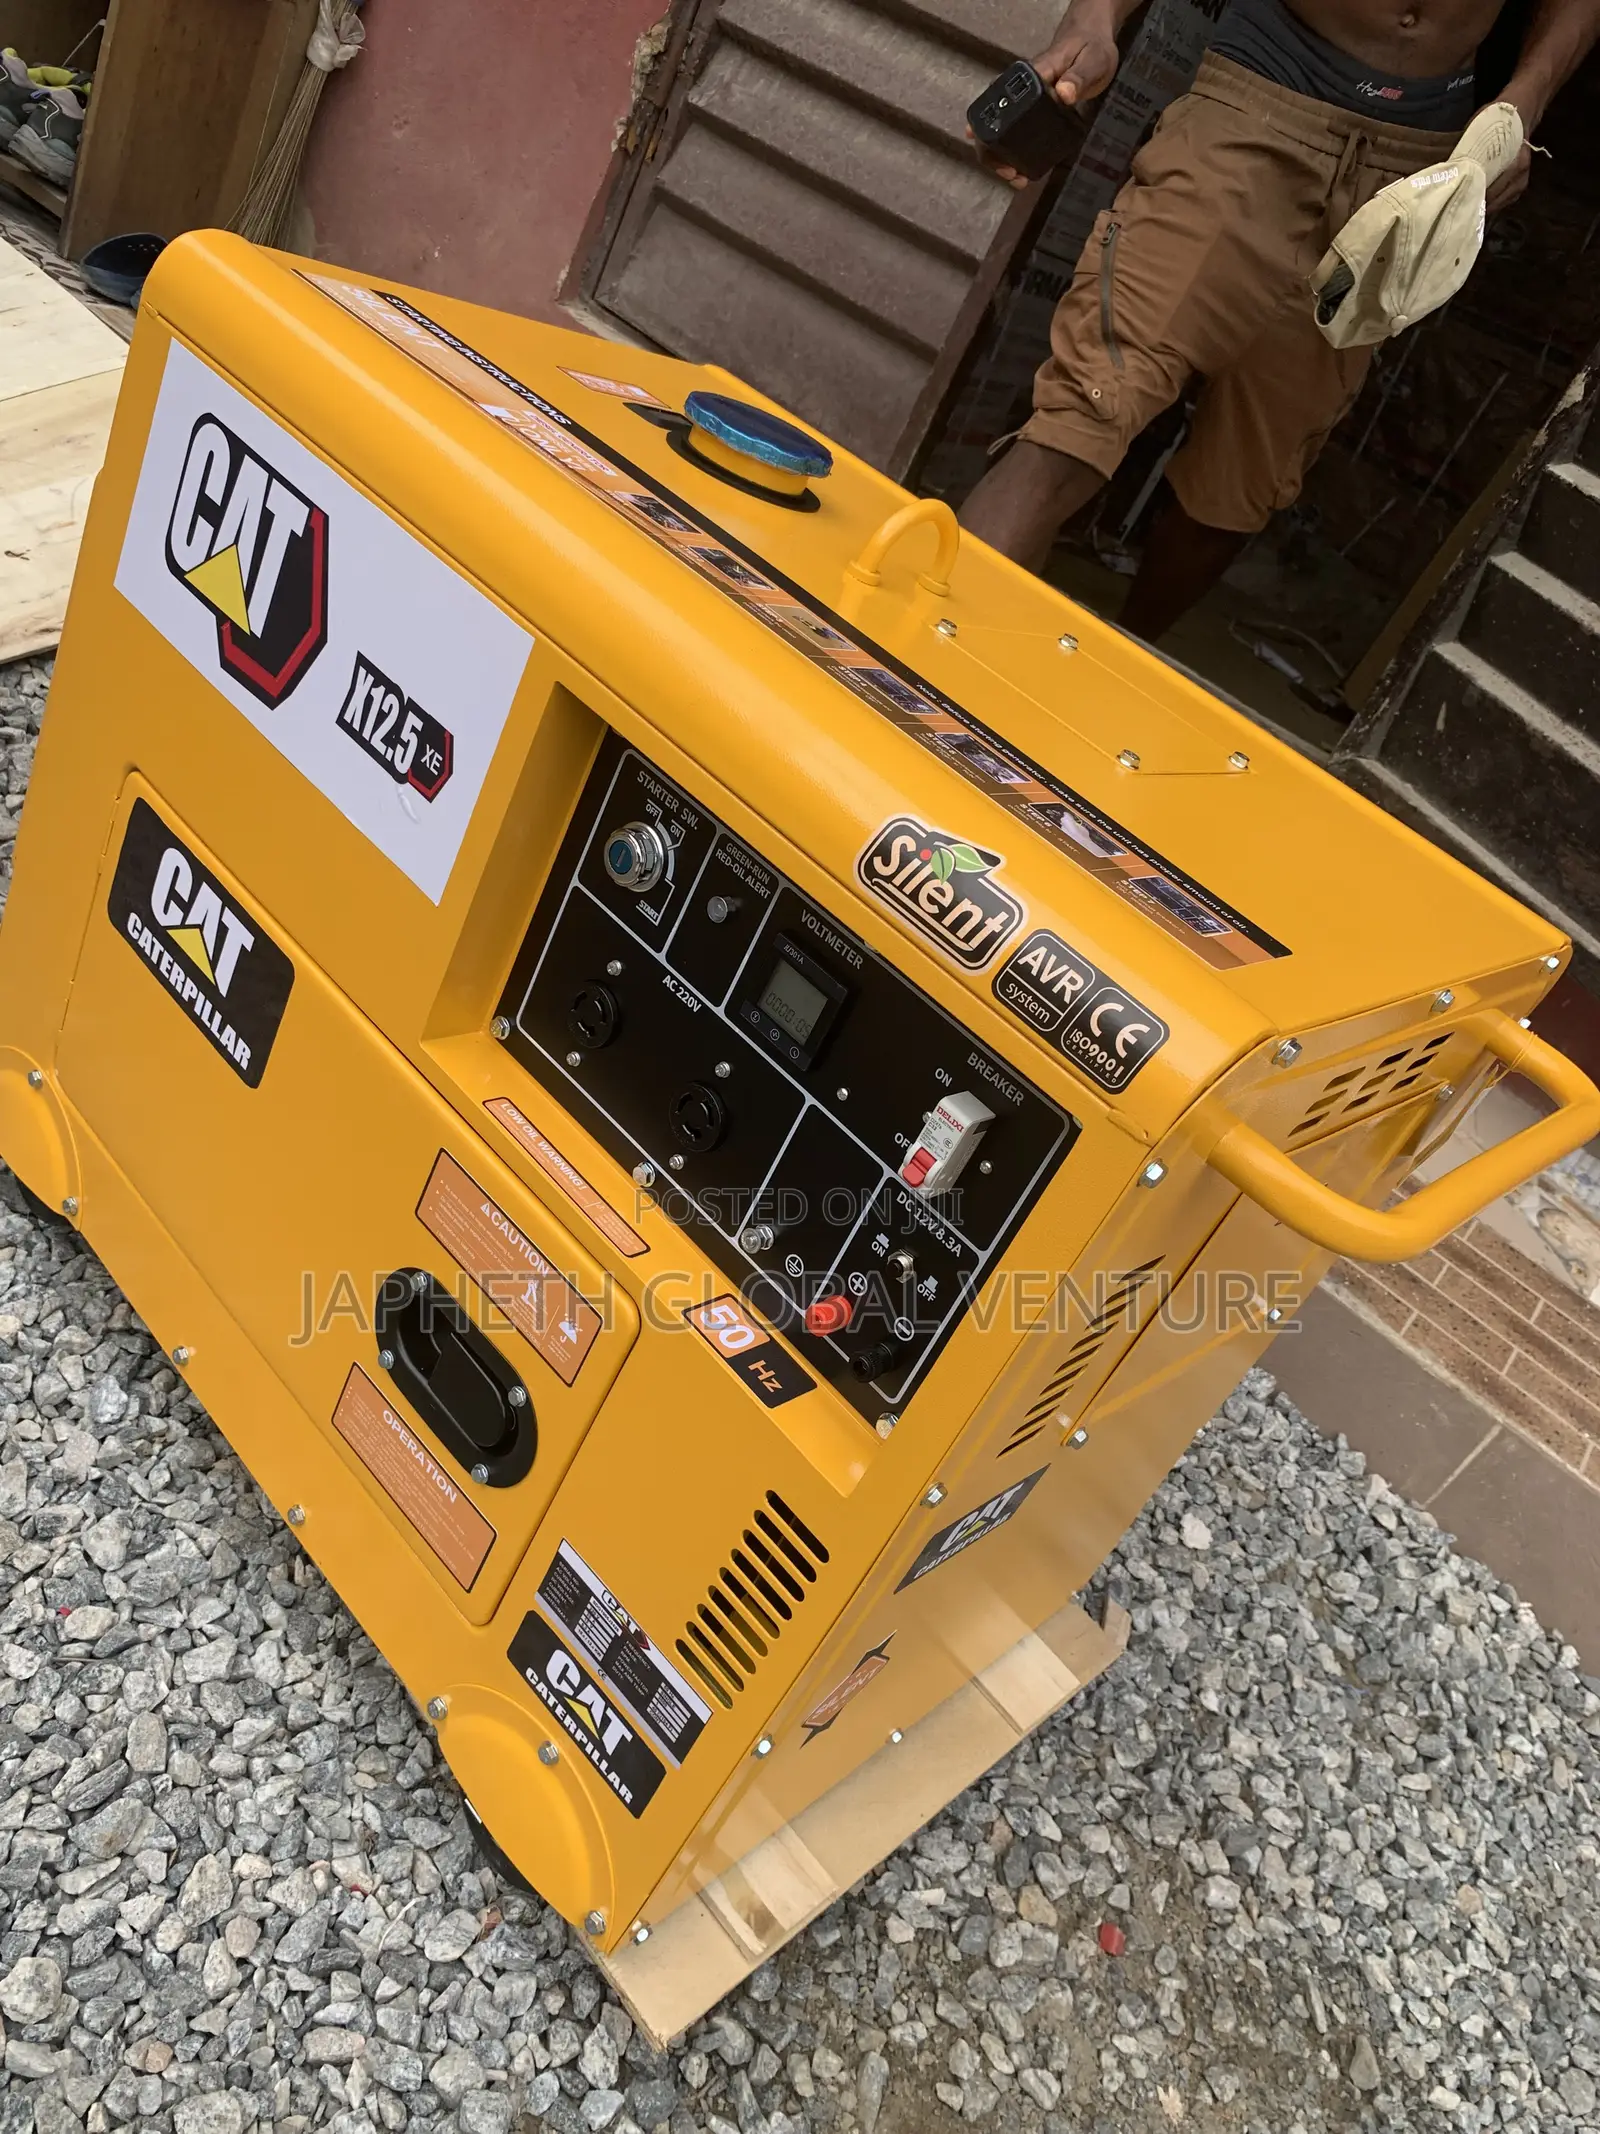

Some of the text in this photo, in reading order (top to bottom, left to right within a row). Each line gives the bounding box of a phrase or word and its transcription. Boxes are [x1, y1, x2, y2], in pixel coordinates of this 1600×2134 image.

[386, 295, 462, 348] STARTING
[457, 345, 572, 426] INSTRUCTIONS
[171, 423, 310, 638] CAT
[343, 666, 443, 776] X12.5 XE
[636, 770, 699, 830] STARTER SW.
[645, 803, 659, 818] OFF
[670, 825, 681, 838] ON
[715, 848, 772, 900] RED-OIL ALERT
[725, 842, 771, 884] GREEN-RUN
[638, 899, 660, 921] START
[873, 835, 1009, 950] Silent
[151, 847, 255, 998] CAT
[800, 909, 864, 970] VOLTMETER
[127, 912, 252, 1071] CATERPILLAR
[662, 975, 702, 1013] AC 220V
[1017, 945, 1085, 1005] AVR
[1006, 981, 1051, 1024] system
[934, 1068, 953, 1087] ON
[967, 1052, 1025, 1106] BREAKER
[1066, 1039, 1117, 1084] CERTIFIED
[500, 1103, 526, 1125] LOW
[522, 1124, 539, 1142] OIL
[937, 1106, 964, 1132] DELIXI
[490, 1211, 550, 1277] CAUTION
[871, 1241, 885, 1258] ON
[896, 1191, 912, 1212] DC
[935, 1227, 963, 1258] 8.3A
[917, 1283, 936, 1302] OFF
[700, 1305, 755, 1349] 50
[383, 1409, 458, 1504] OPERATION
[940, 1482, 1024, 1552] CAT
[602, 1590, 641, 1634] CAT
[545, 1649, 633, 1756] CAT
[526, 1667, 634, 1804] CATERPILLAR
